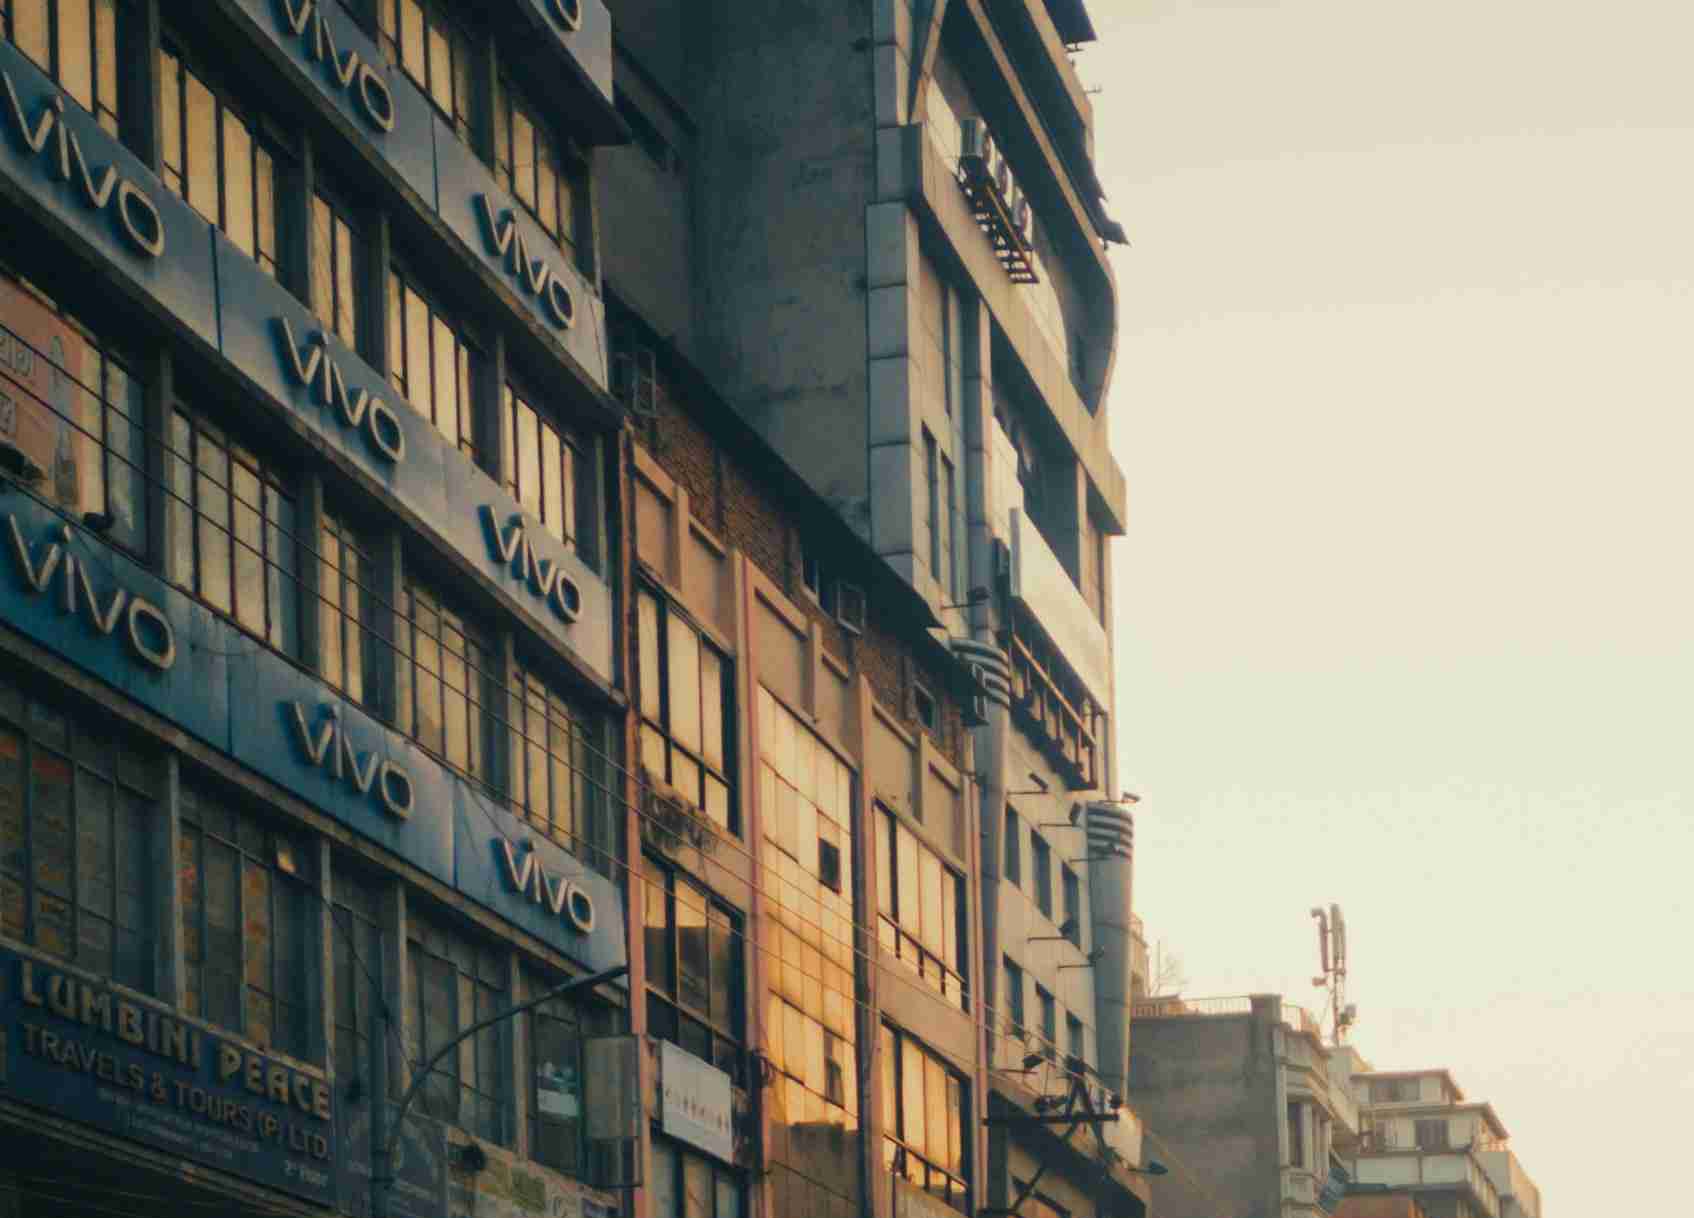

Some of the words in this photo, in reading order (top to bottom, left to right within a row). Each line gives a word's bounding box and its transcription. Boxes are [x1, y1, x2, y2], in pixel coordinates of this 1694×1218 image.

[22, 960, 201, 1071] LUMBINI
[23, 1023, 144, 1090] TRAVELS
[151, 1071, 167, 1104] &
[175, 1081, 250, 1130] TOURS
